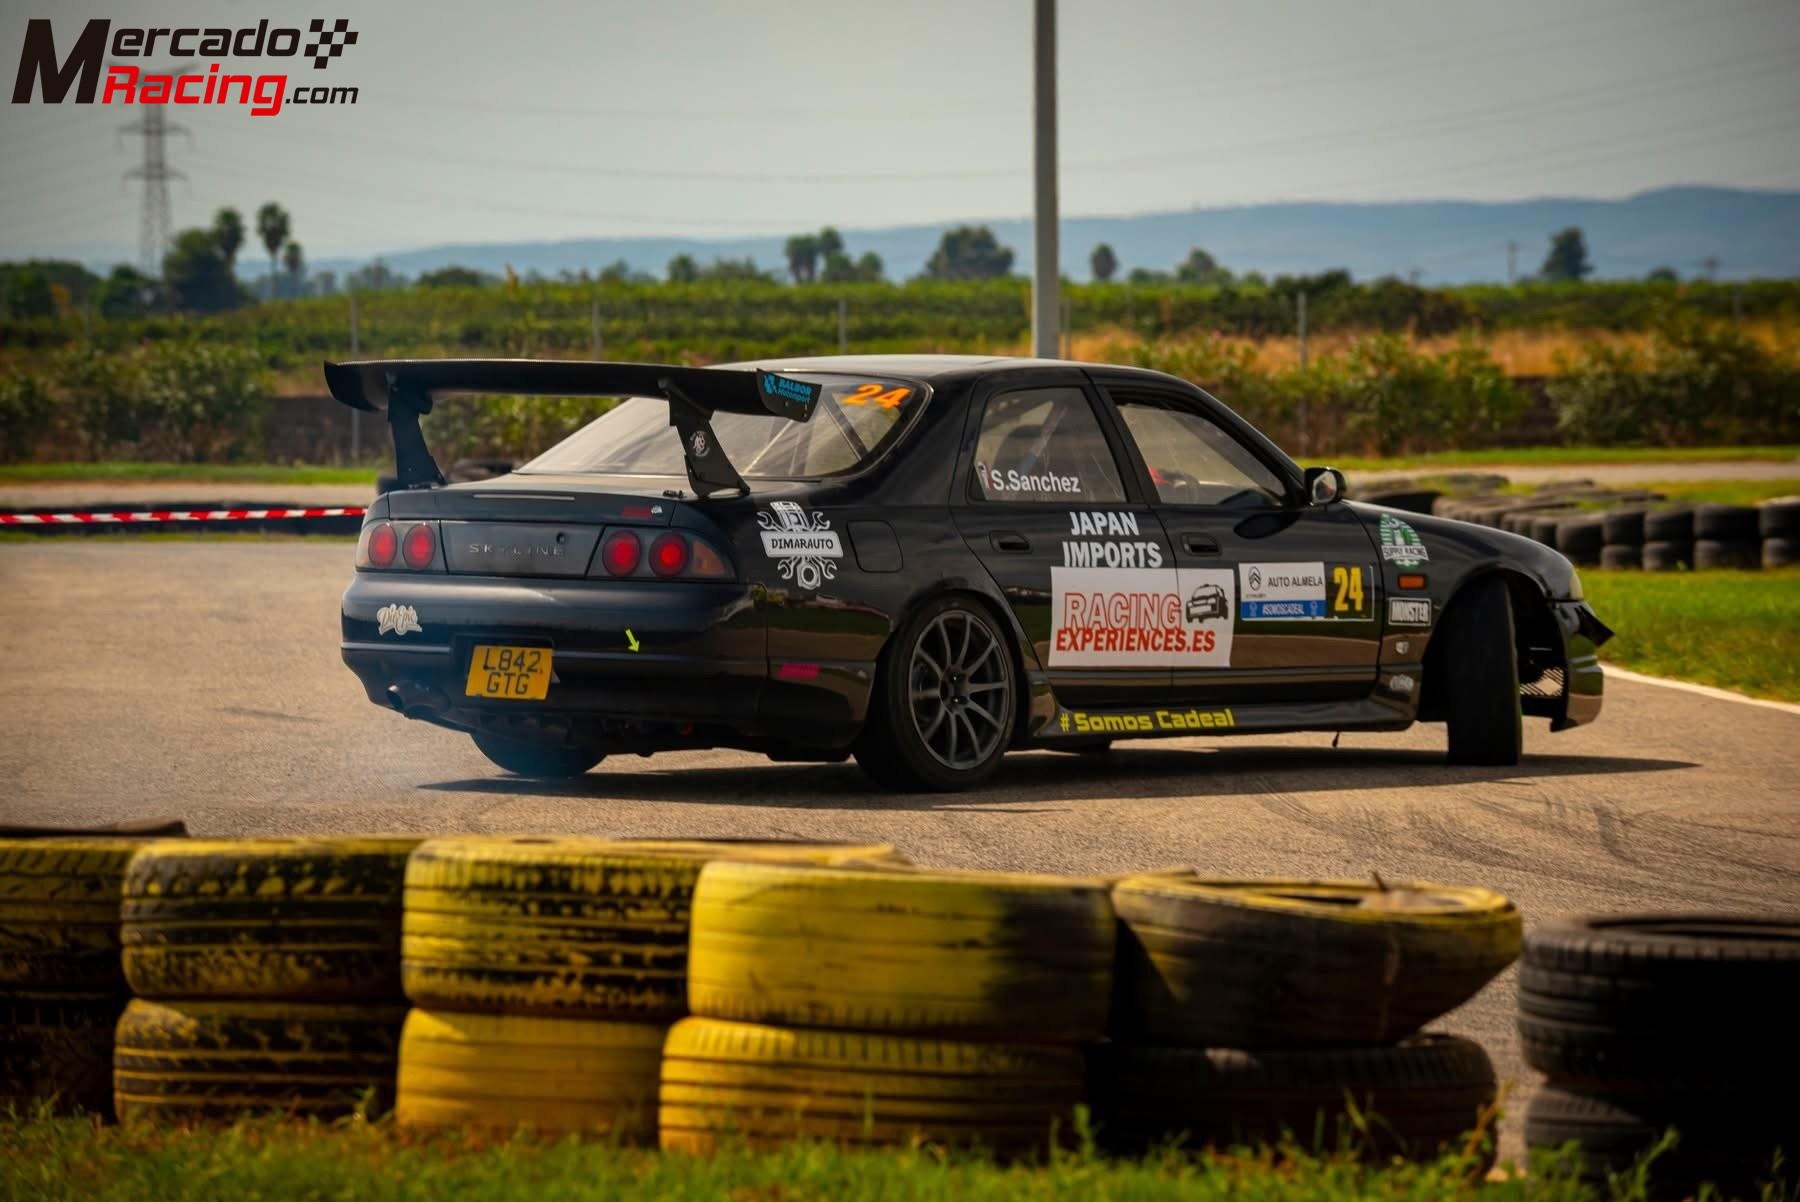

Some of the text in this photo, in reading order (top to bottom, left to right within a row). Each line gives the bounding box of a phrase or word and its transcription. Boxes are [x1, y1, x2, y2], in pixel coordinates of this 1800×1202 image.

[843, 383, 911, 409] 24
[991, 469, 1082, 493] S.Sanchez
[1069, 511, 1140, 536] JAPAN
[469, 543, 565, 556] SKYLINE
[771, 538, 834, 550] DIMARAUTO
[1062, 541, 1163, 568] IMPORTS
[1267, 575, 1324, 588] AUTO ALMELA
[1333, 566, 1364, 611] 24
[1064, 592, 1182, 632] RACING
[1391, 600, 1429, 622] MONSTER
[1056, 629, 1216, 652] EXPERIENCES.ES
[483, 648, 541, 673] L842
[486, 671, 530, 695] GTG
[1074, 712, 1153, 732] Somos
[1156, 708, 1235, 729] Cadeal
